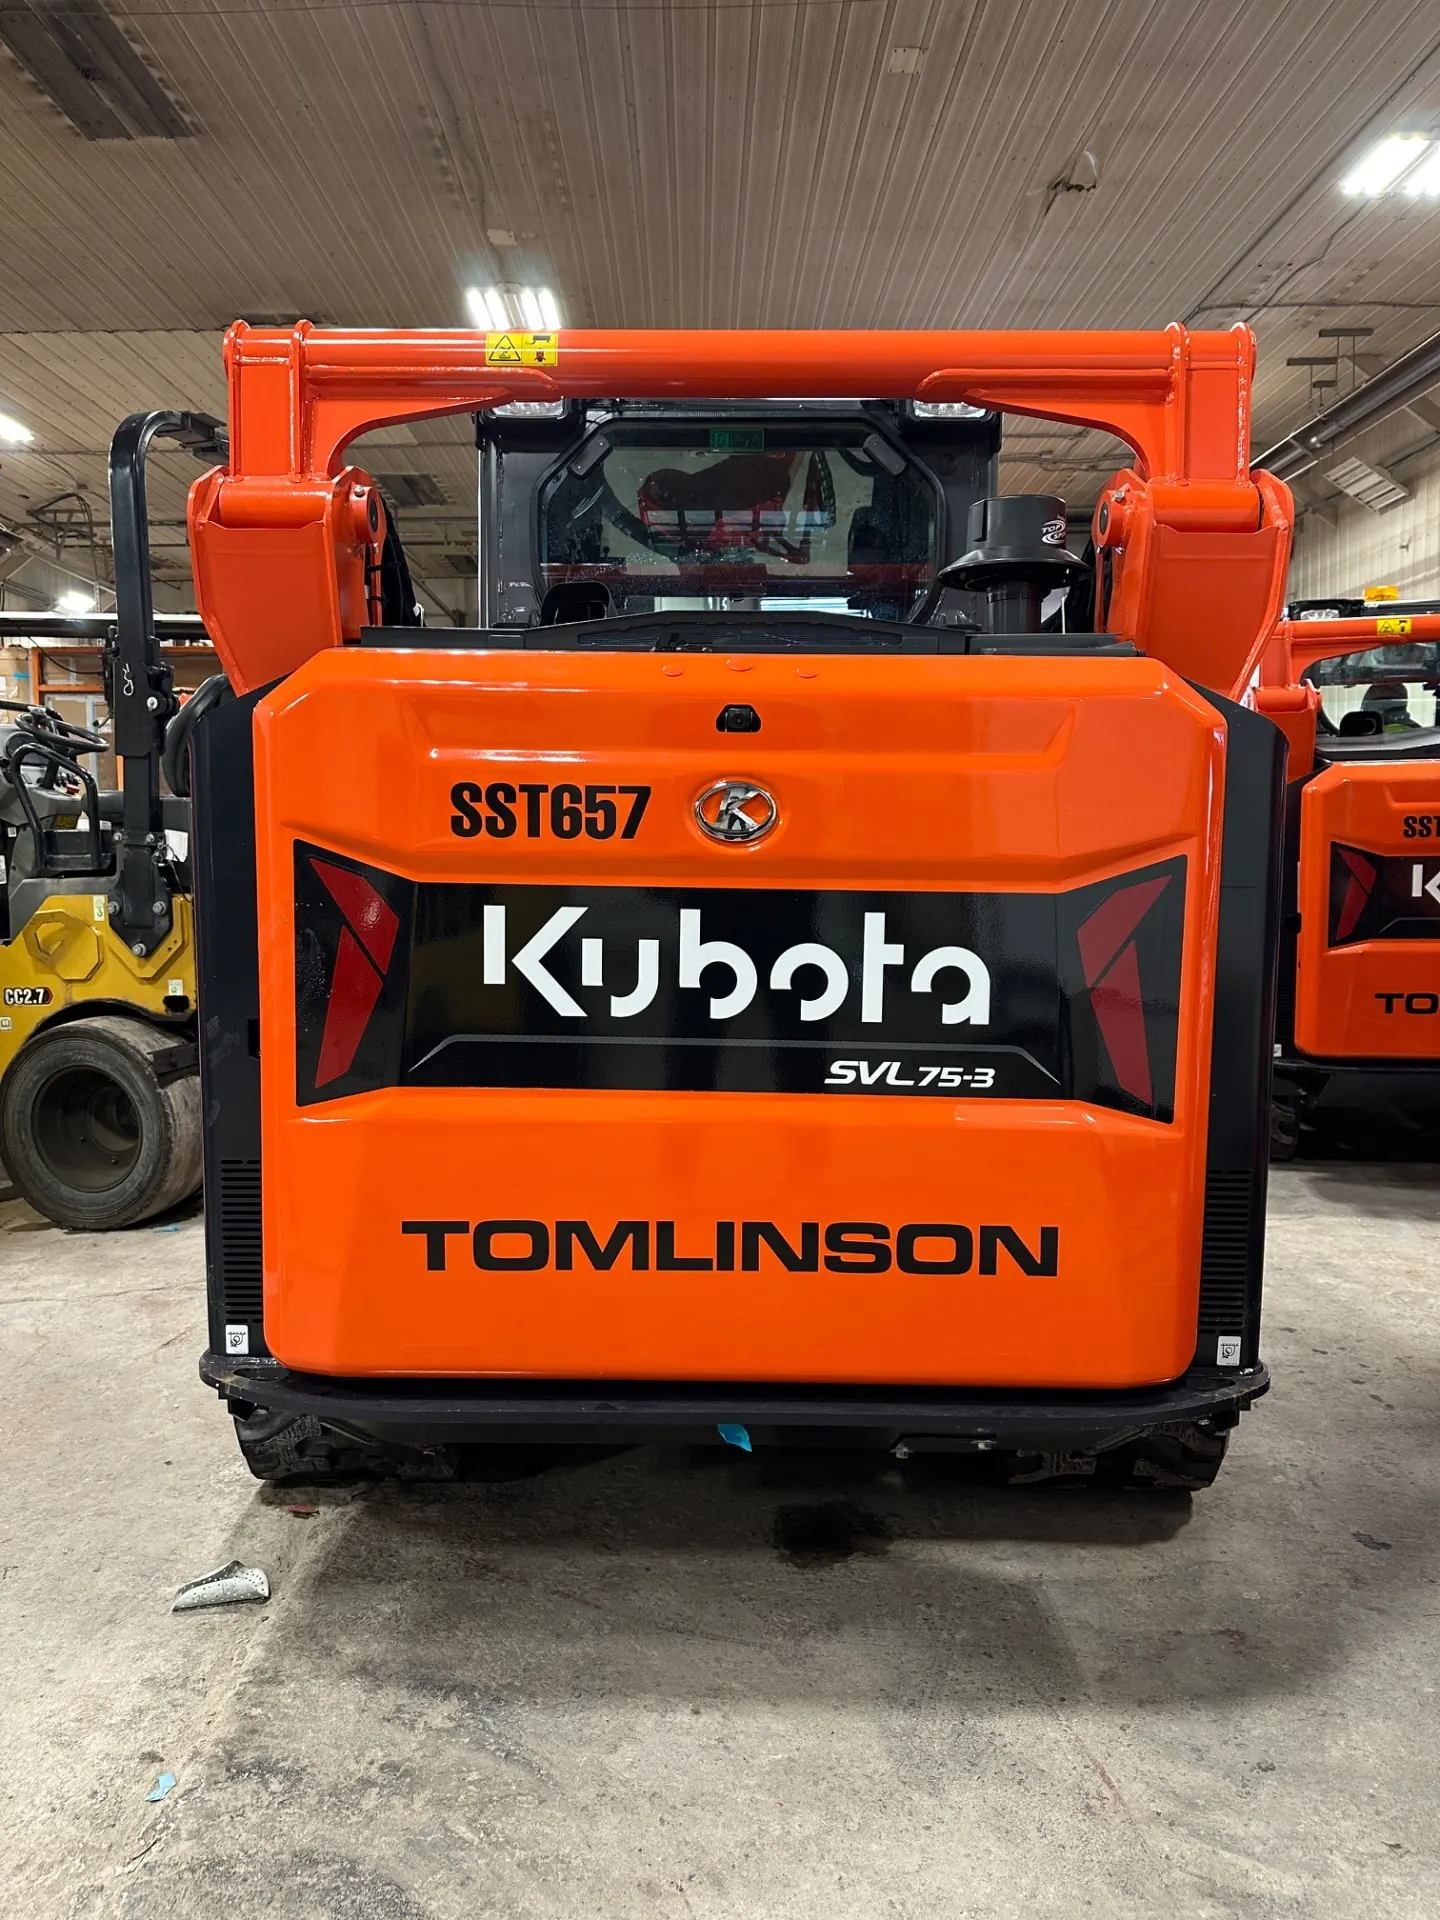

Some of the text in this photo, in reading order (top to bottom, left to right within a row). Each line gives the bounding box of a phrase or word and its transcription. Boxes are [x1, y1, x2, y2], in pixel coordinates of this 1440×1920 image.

[1041, 524, 1062, 534] TOP
[451, 782, 652, 840] SST657
[483, 903, 992, 1025] Kubota
[5, 988, 45, 1005] CC2.7
[1374, 993, 1439, 1015] TO
[401, 1219, 1059, 1277] TOMLINSON
